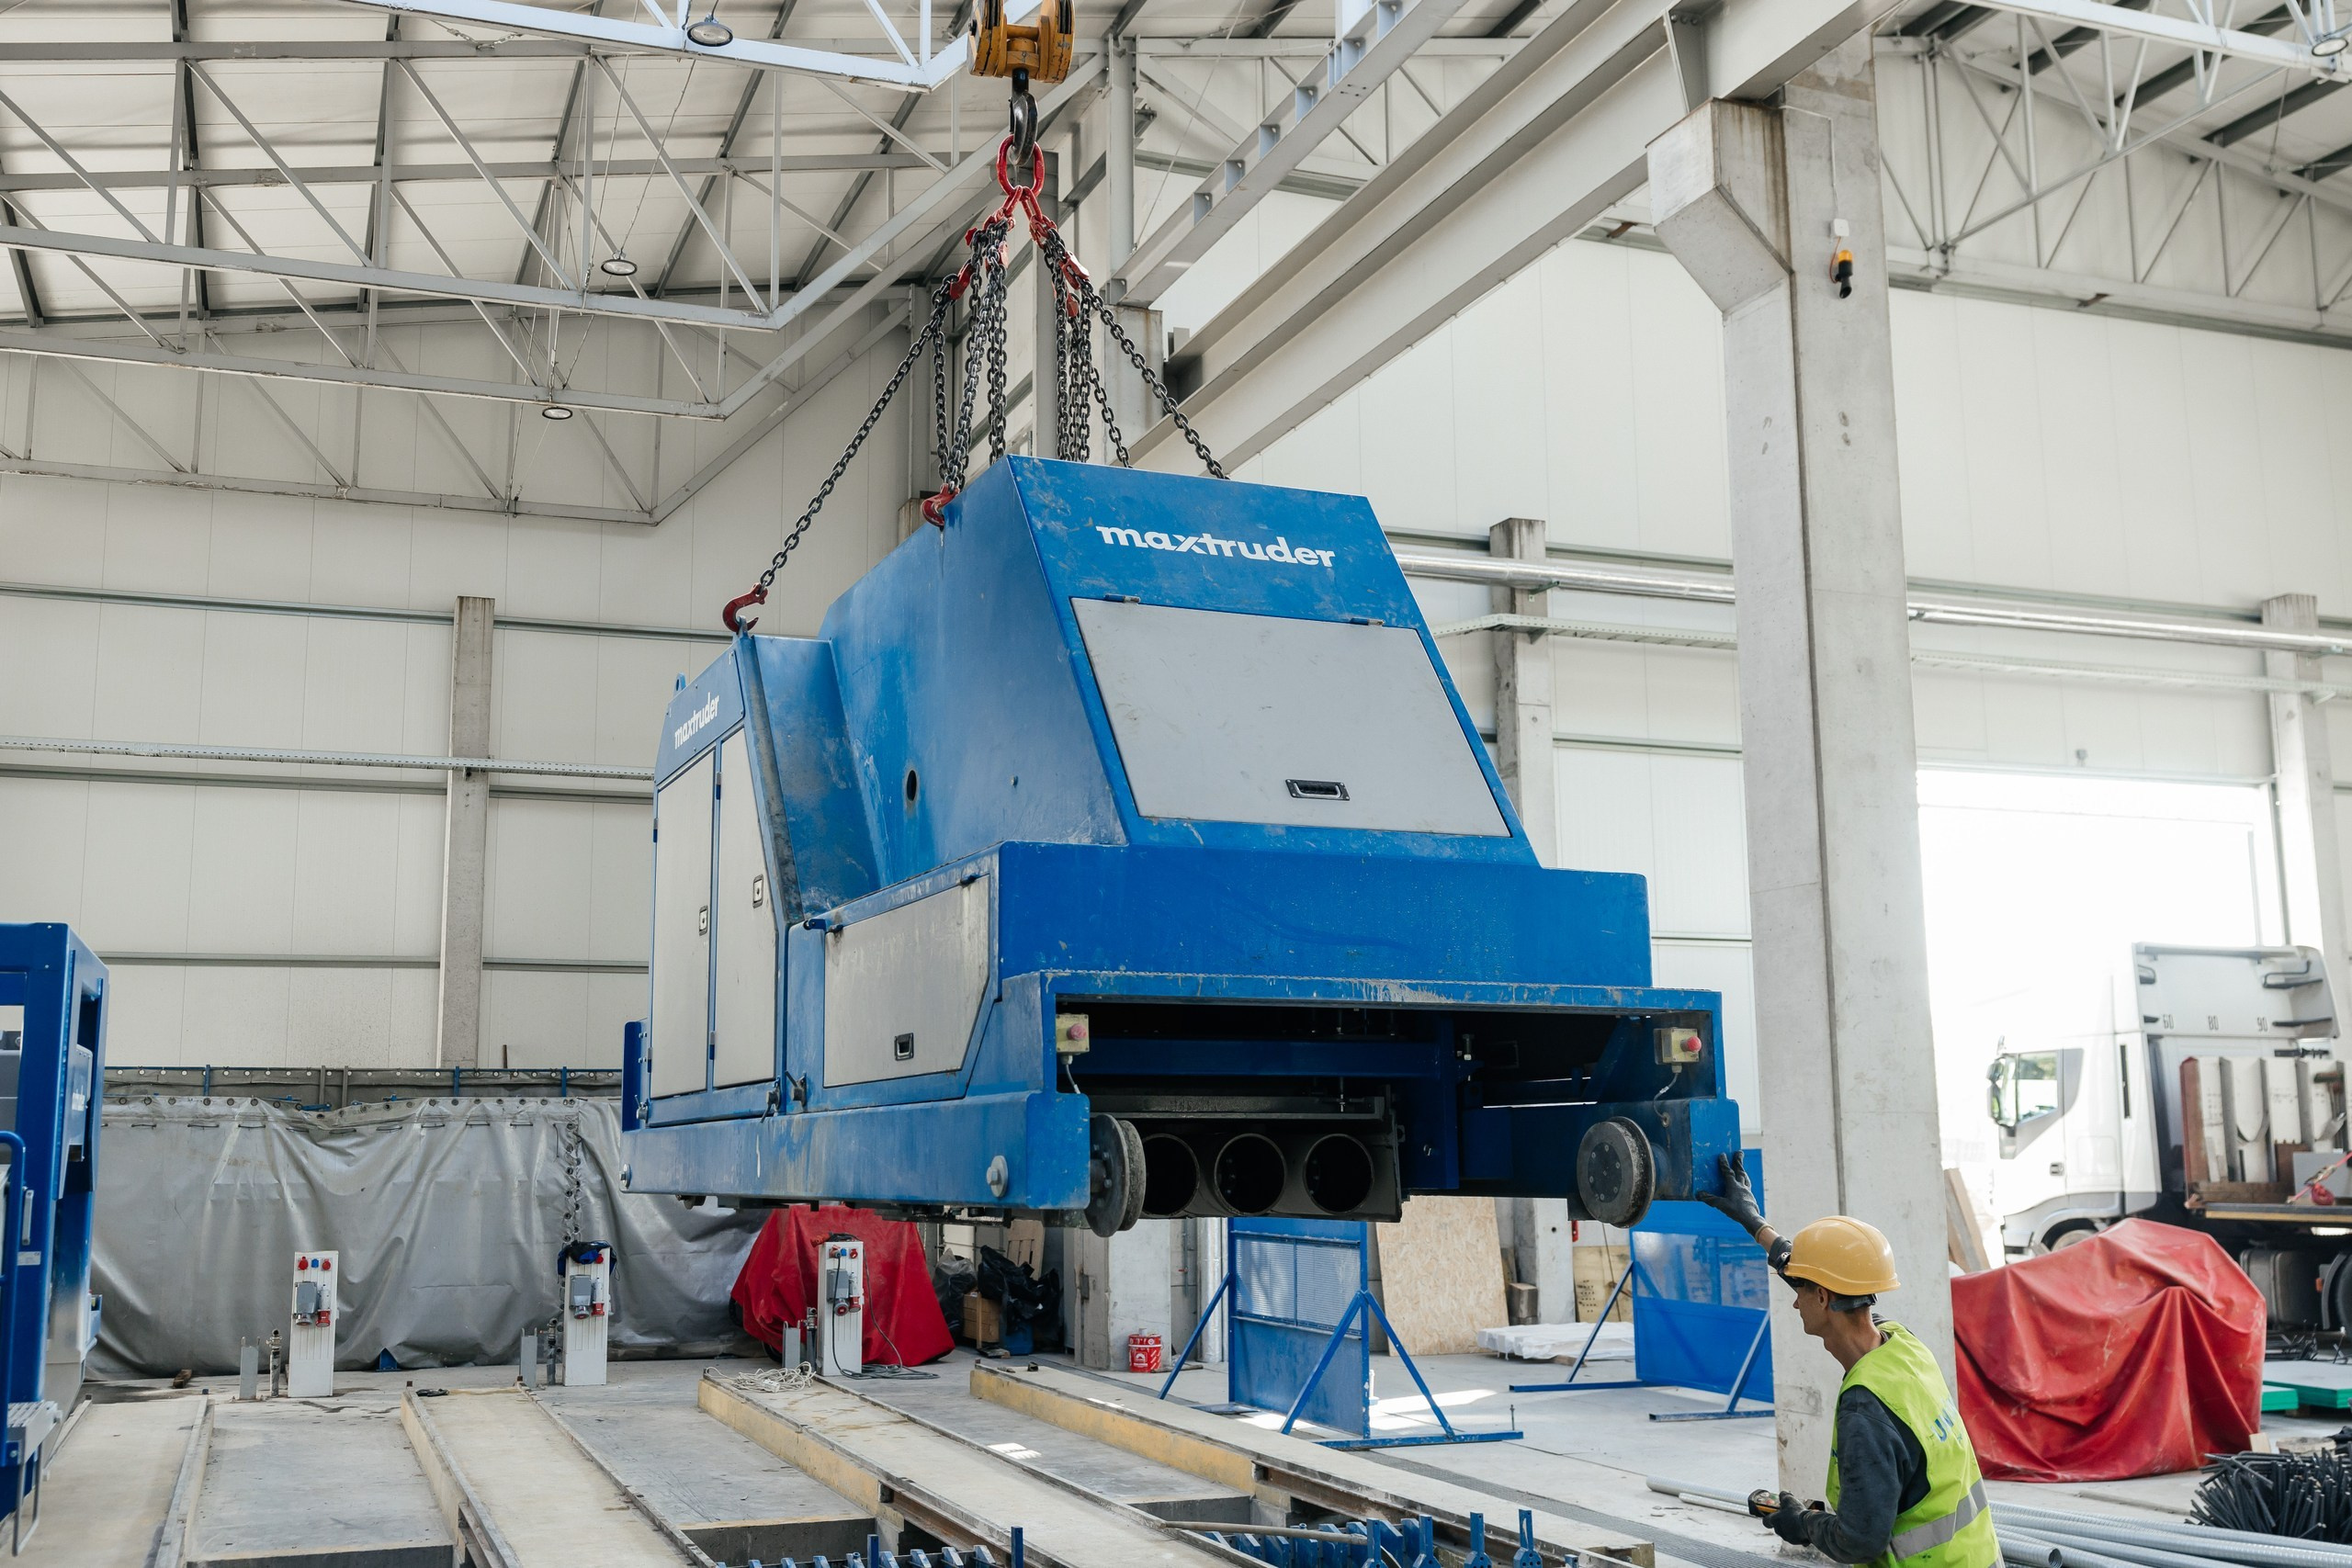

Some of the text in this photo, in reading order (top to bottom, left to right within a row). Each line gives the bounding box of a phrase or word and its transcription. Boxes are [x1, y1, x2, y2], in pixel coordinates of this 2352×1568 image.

[1096, 525, 1336, 568] maxtruder
[674, 692, 719, 750] maxtruder
[2162, 1013, 2174, 1030] 60
[2256, 1016, 2268, 1032] 90
